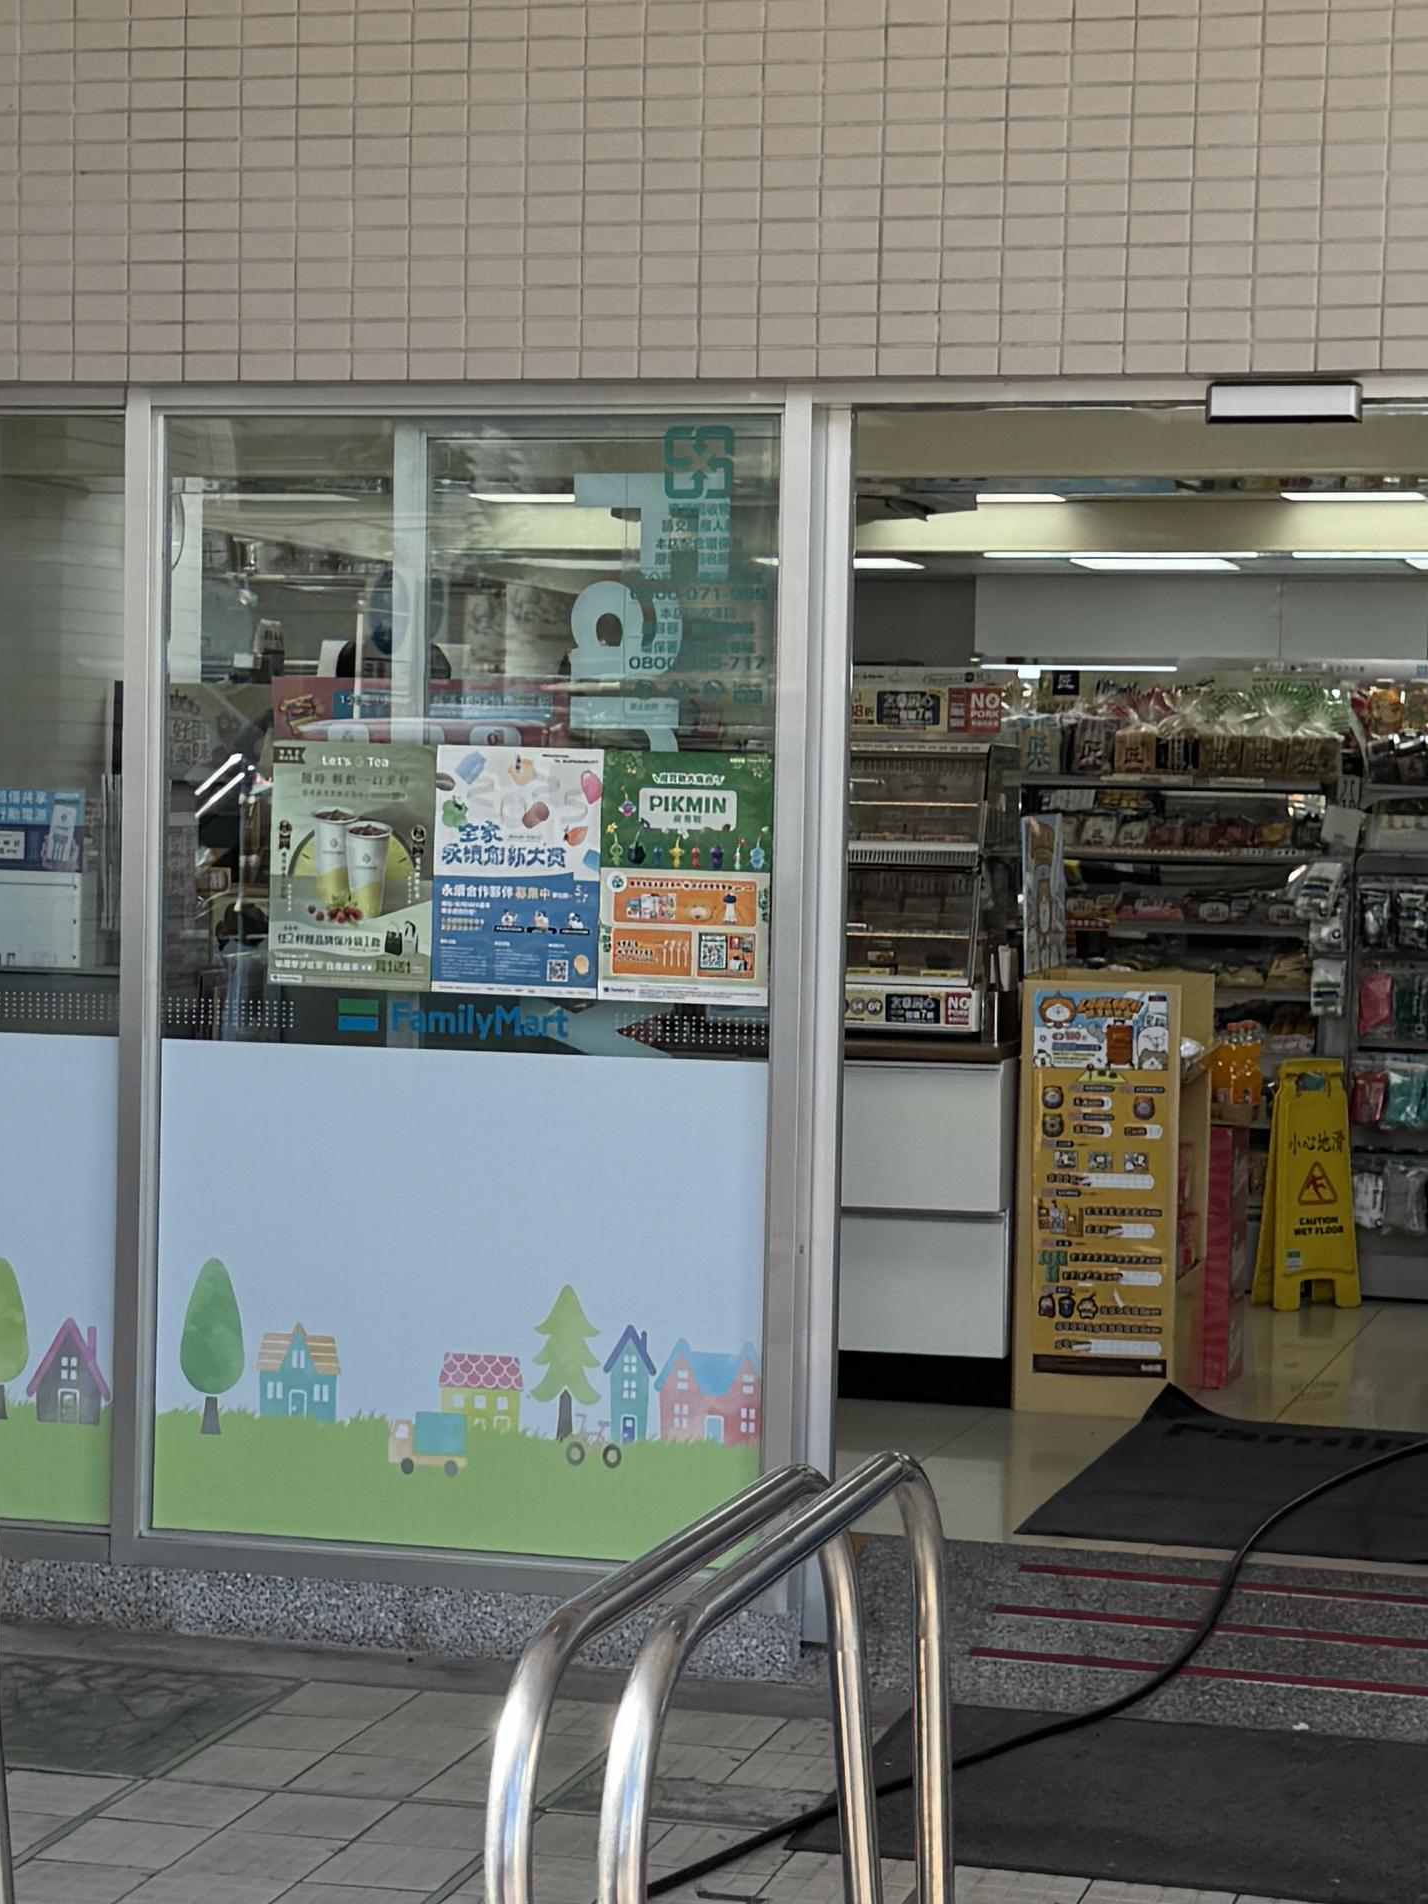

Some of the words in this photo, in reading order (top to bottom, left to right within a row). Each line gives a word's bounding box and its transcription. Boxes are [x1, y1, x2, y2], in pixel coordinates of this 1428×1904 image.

[970, 692, 1001, 710] NO
[322, 755, 352, 768] Let's
[367, 756, 390, 768] Tea
[649, 795, 727, 814] PIKMIN
[458, 820, 503, 843] 全家
[391, 1000, 569, 1041] FamilyMart
[1288, 1128, 1345, 1156] 小心地滑
[1299, 1216, 1339, 1226] CAUTION
[1293, 1226, 1313, 1236] WET
[1315, 1225, 1344, 1236] FLOOR
